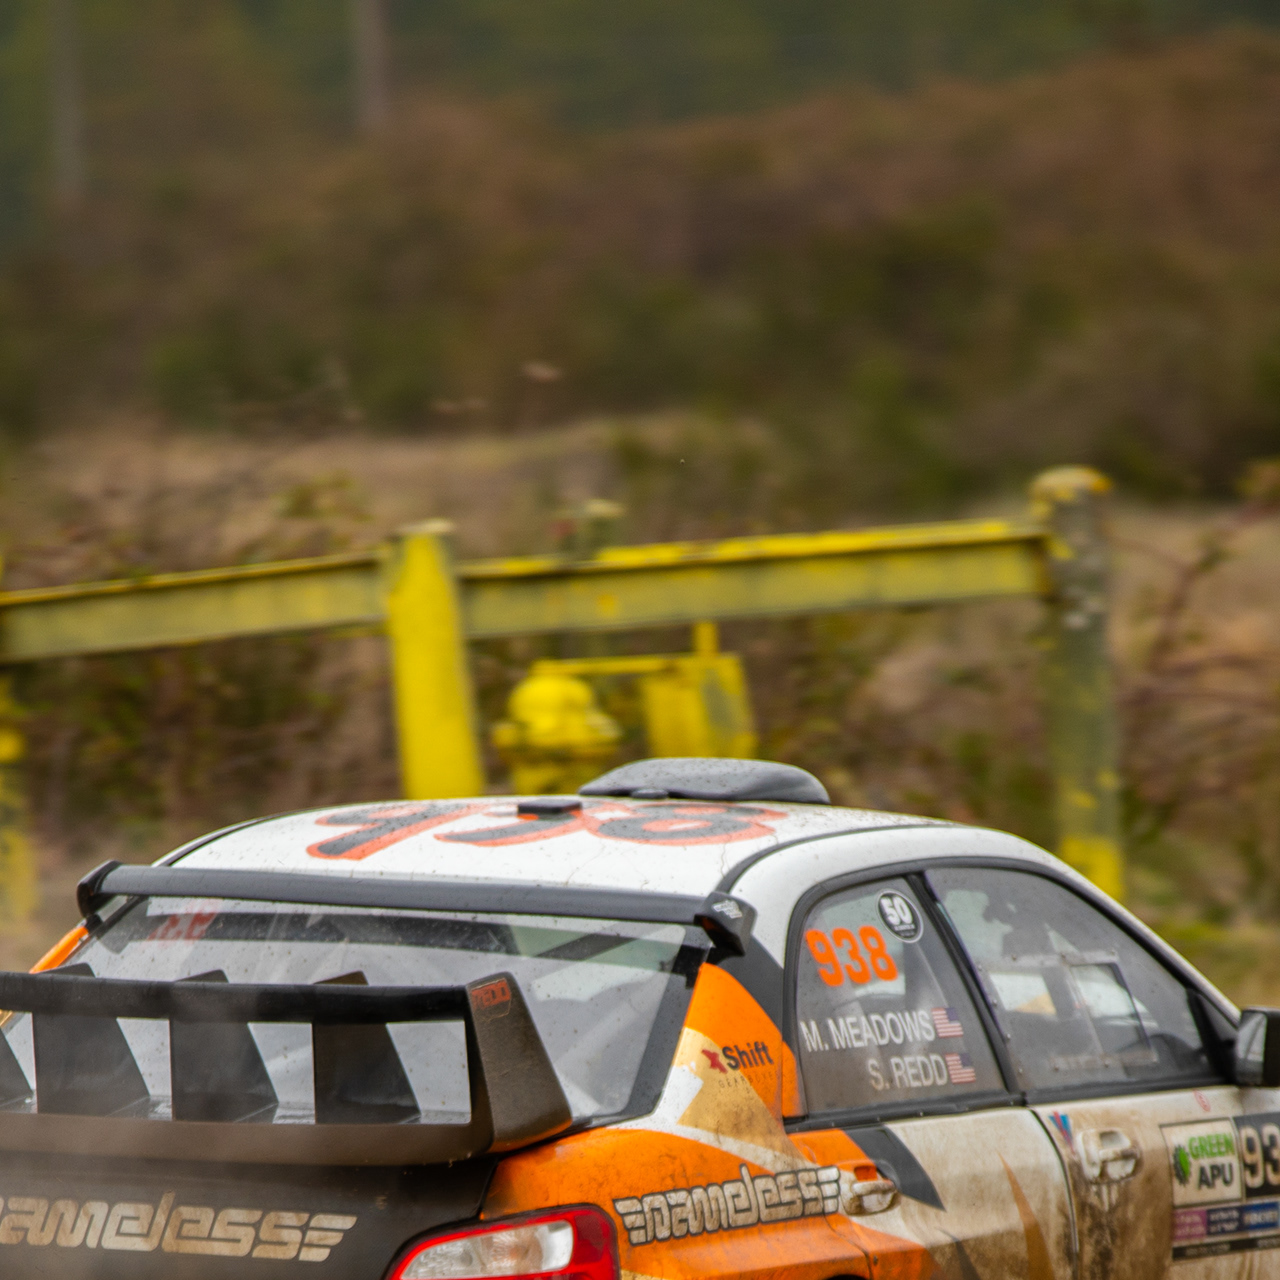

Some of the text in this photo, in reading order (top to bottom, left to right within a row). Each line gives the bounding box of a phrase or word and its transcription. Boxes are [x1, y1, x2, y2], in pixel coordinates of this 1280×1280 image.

[880, 896, 913, 925] 50
[805, 925, 898, 987] 938
[800, 1010, 936, 1052] M. MEADOWS
[867, 1053, 949, 1091] S. REDD
[1188, 1132, 1236, 1160] GREEN
[1196, 1162, 1234, 1190] APU
